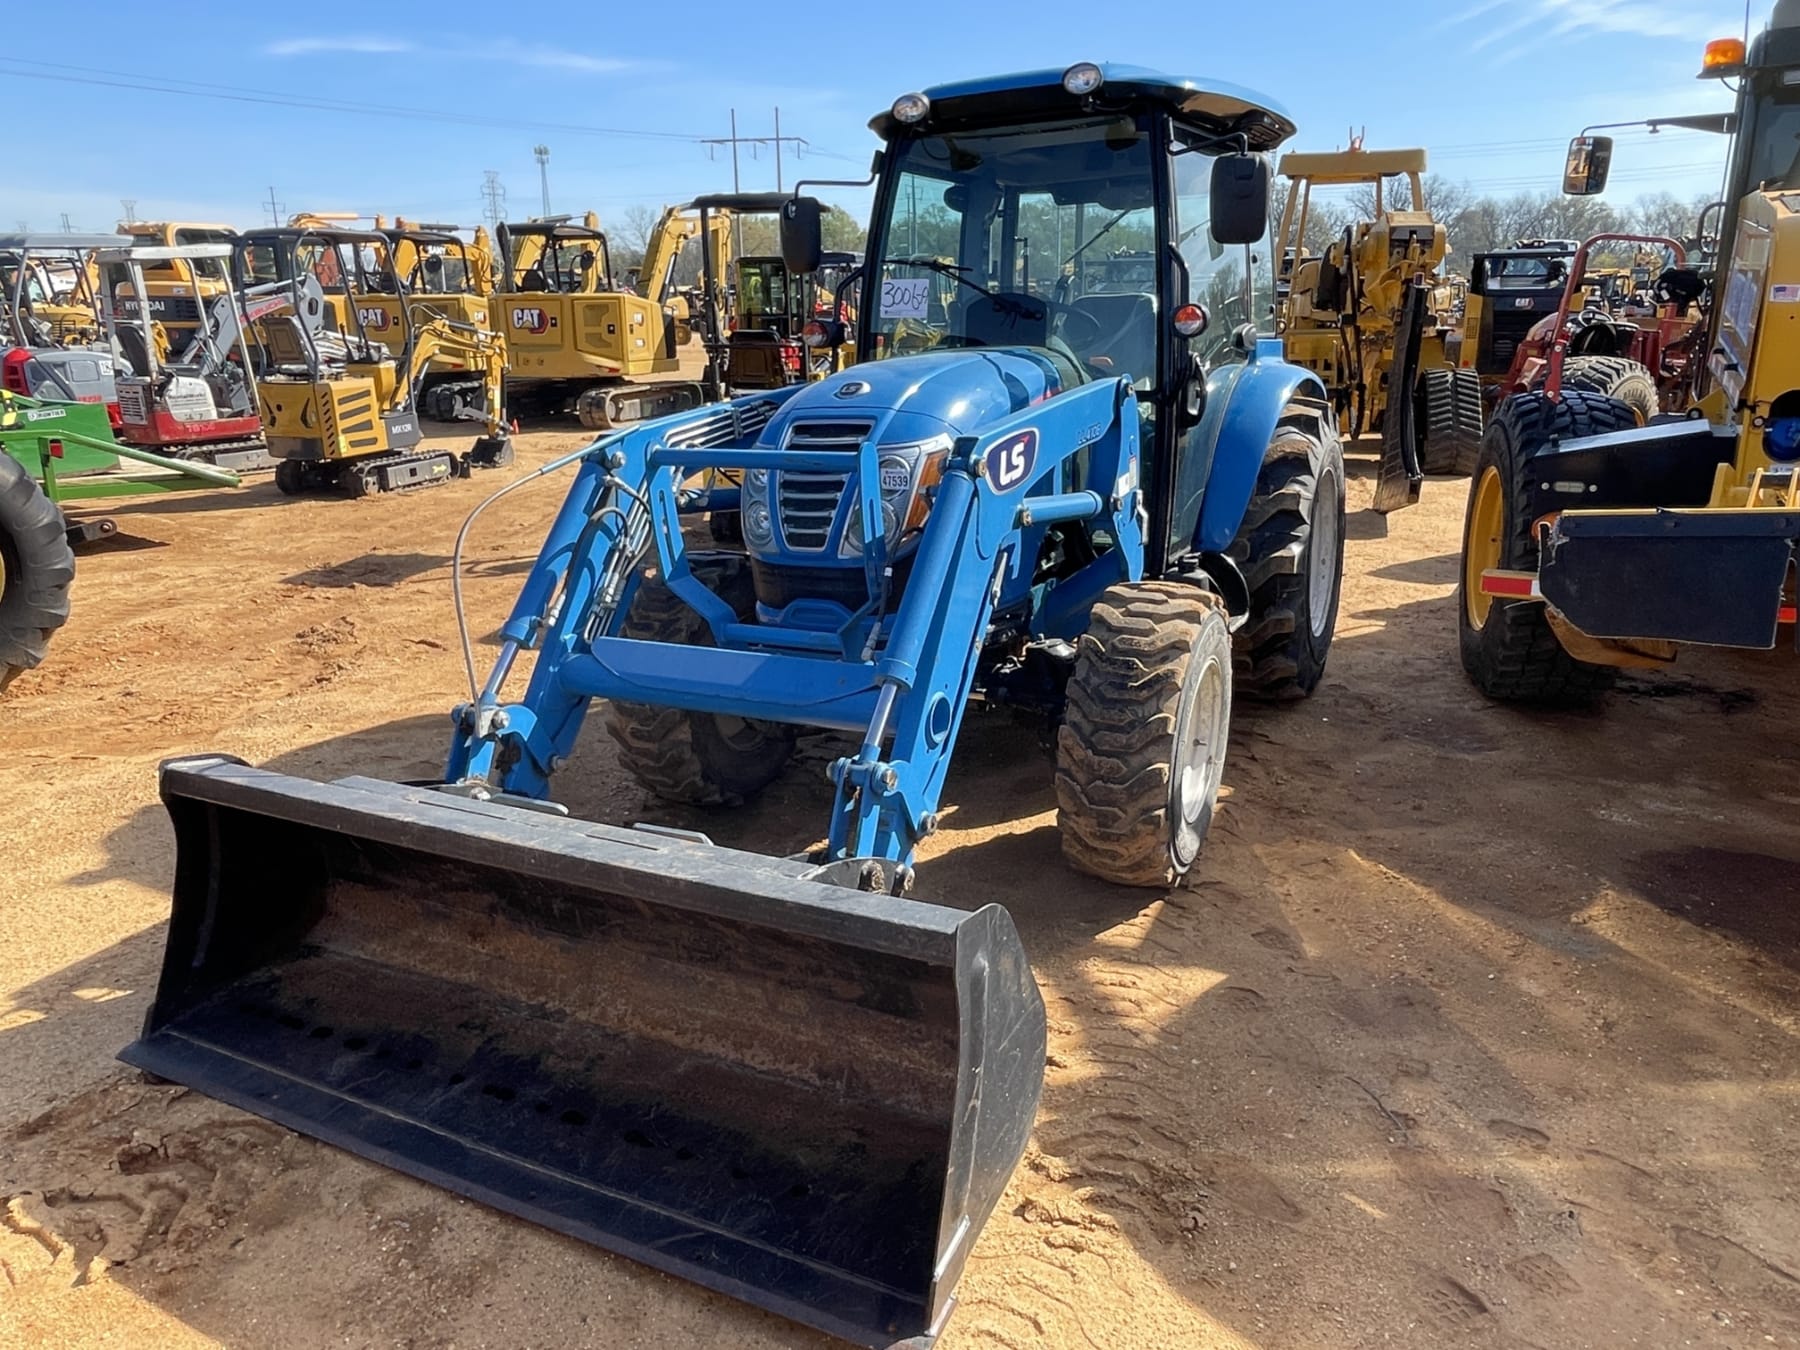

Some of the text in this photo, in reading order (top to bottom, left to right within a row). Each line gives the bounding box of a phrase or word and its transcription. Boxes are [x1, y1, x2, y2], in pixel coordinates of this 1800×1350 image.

[125, 301, 165, 311] HYUDAI
[358, 308, 383, 326] CAT
[513, 308, 540, 328] CAT
[1000, 441, 1025, 486] LS
[883, 475, 908, 487] 47539
